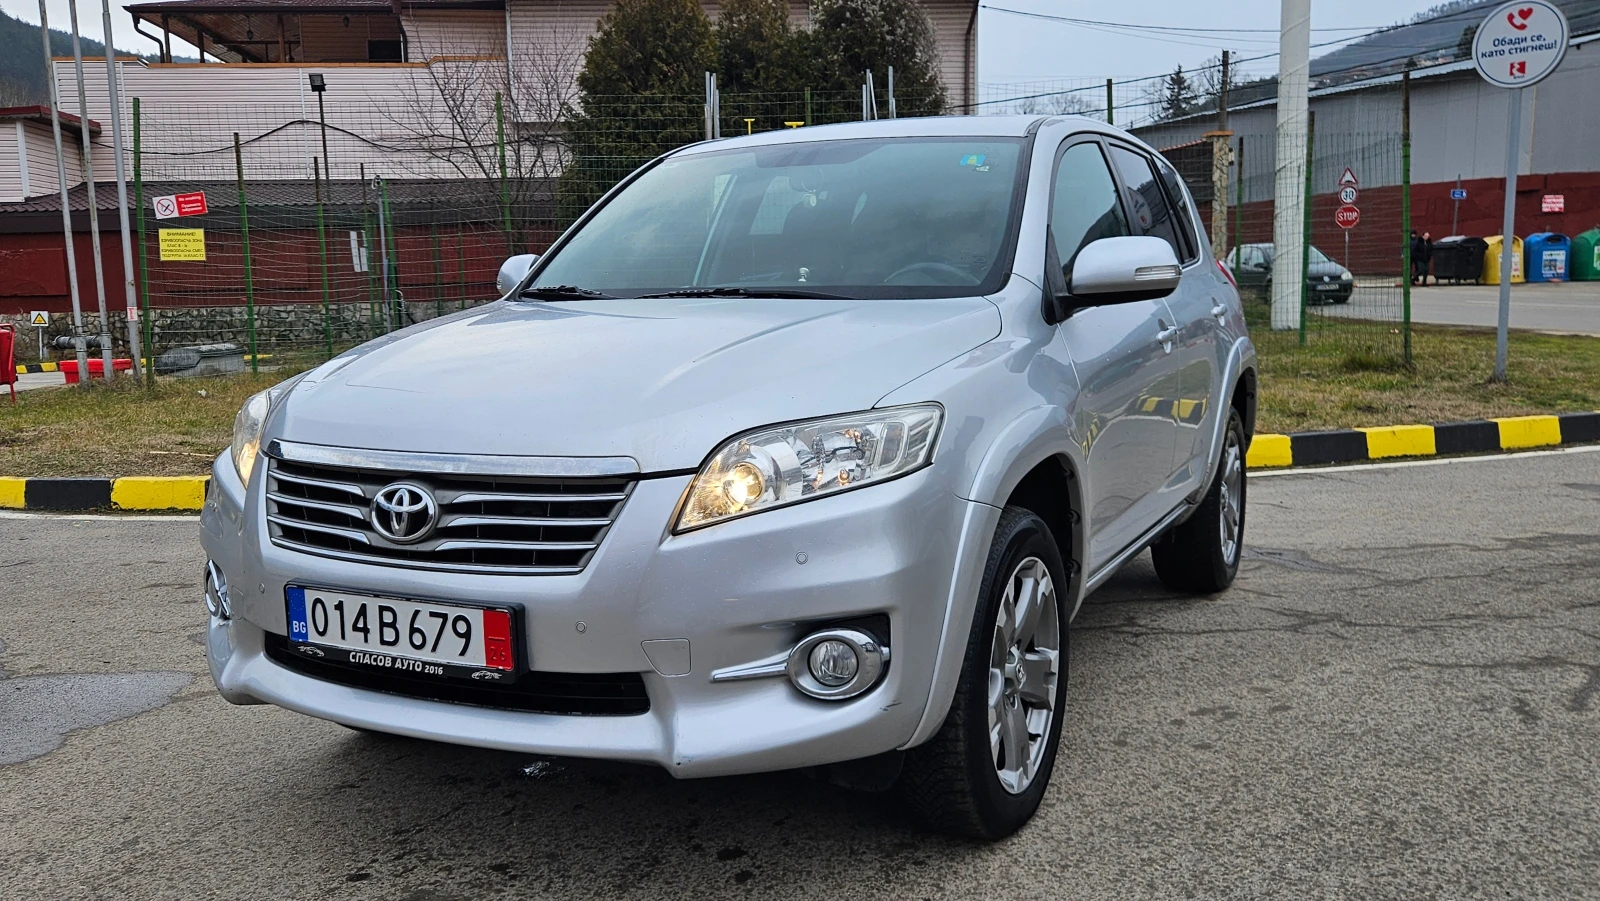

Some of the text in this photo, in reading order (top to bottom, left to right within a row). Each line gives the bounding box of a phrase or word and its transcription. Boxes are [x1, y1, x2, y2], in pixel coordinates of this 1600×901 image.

[1492, 33, 1546, 47] Обади се,
[1481, 40, 1557, 58] като стигнеш!
[1343, 190, 1354, 201] 30
[1337, 211, 1358, 221] STOP
[292, 620, 307, 634] BG
[349, 651, 444, 676] СПАСОВ АУТО 2016
